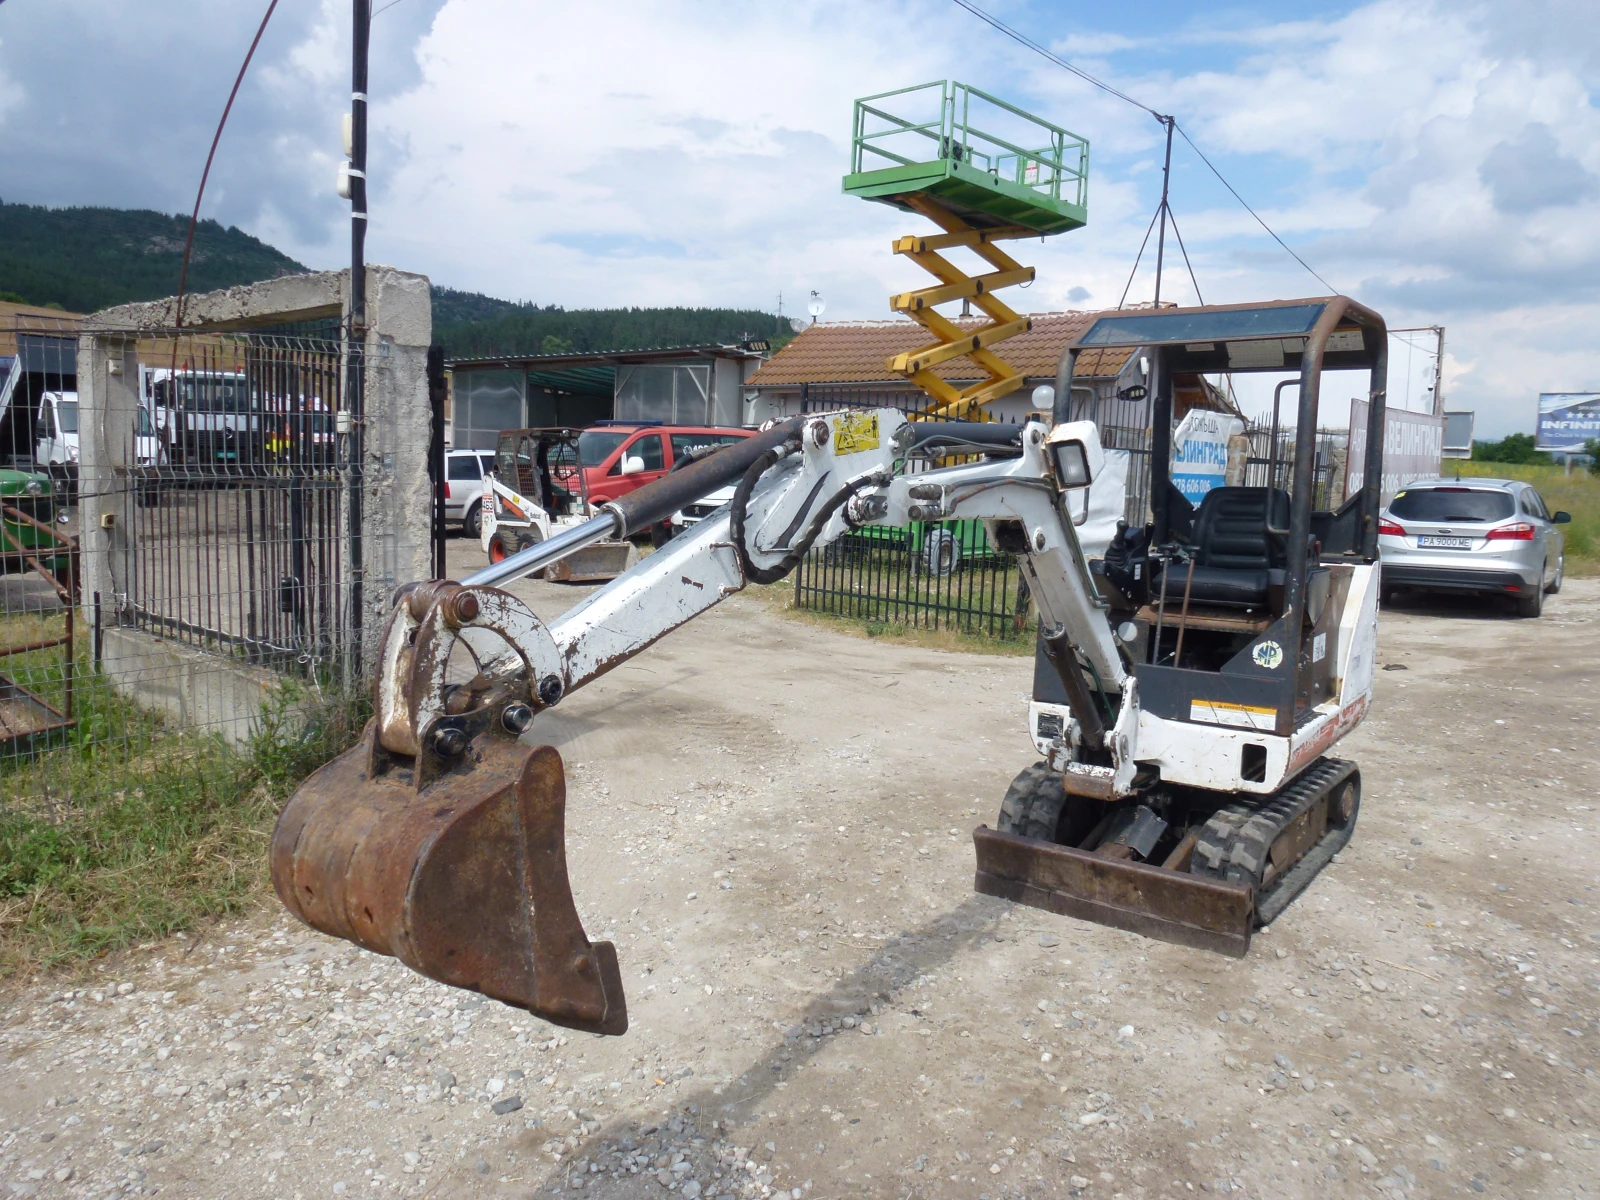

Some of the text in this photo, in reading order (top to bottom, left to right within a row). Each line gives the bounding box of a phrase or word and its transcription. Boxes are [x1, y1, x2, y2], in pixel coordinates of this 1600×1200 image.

[1388, 420, 1442, 464] ВЕЛИНГРАД
[482, 500, 494, 510] 463
[1437, 538, 1457, 546] 9000
